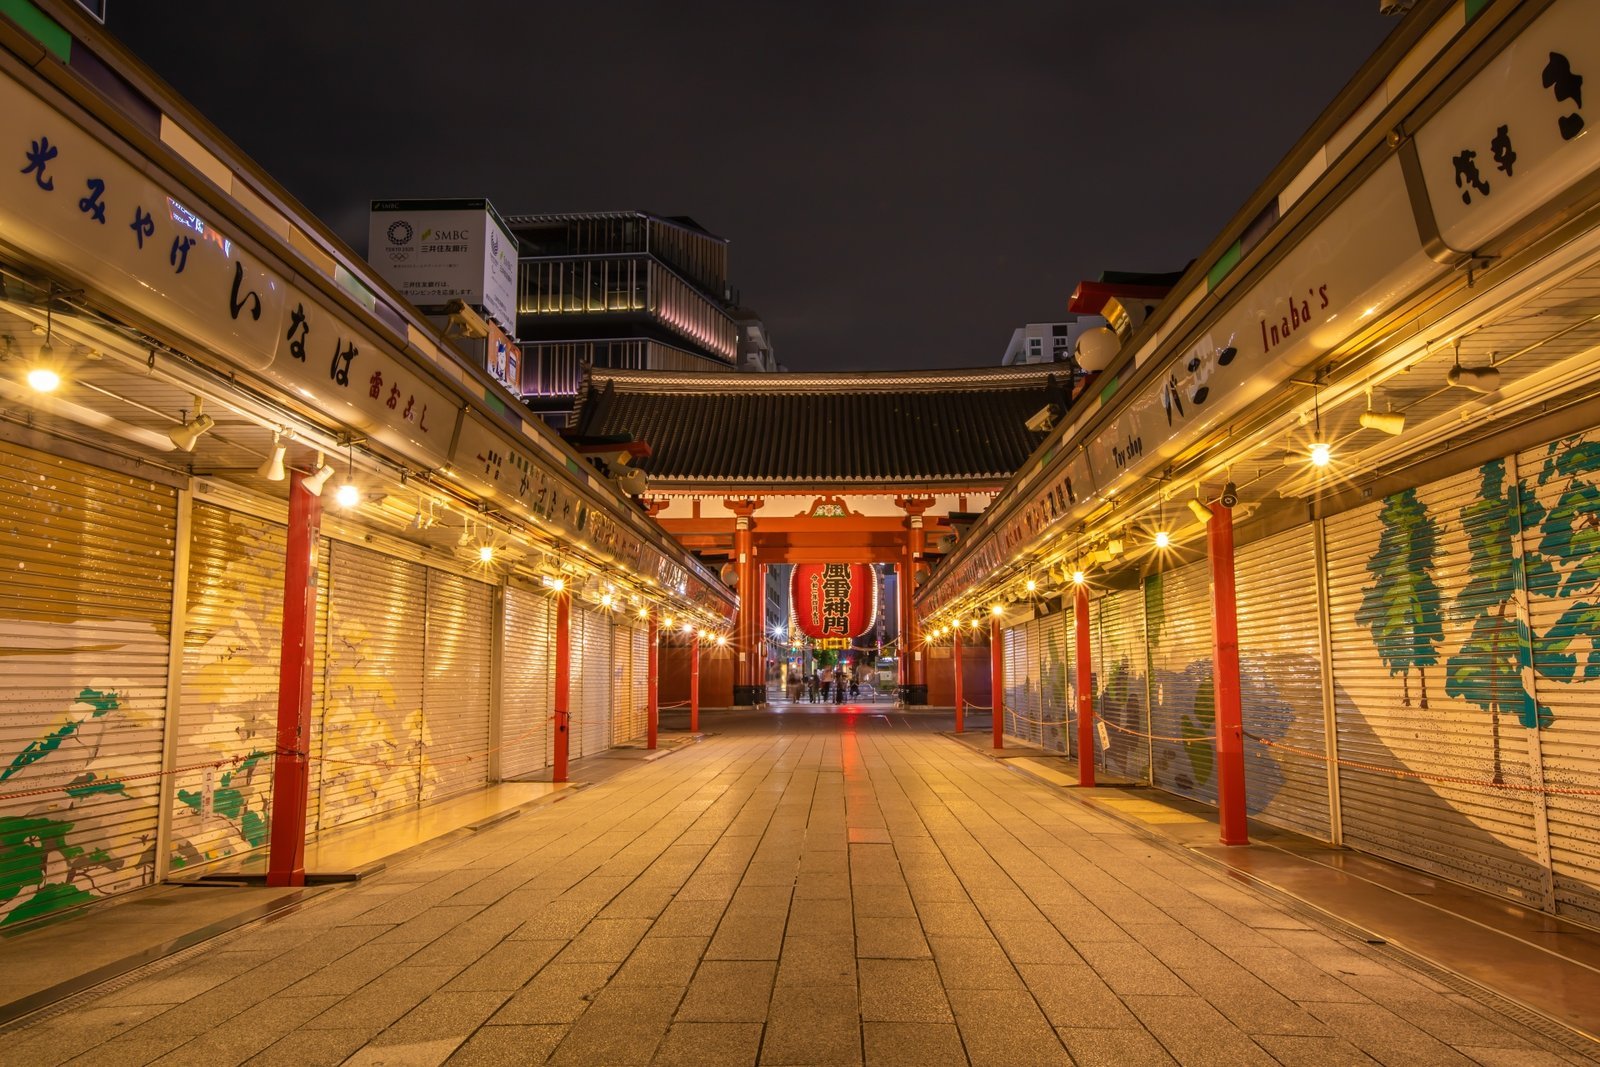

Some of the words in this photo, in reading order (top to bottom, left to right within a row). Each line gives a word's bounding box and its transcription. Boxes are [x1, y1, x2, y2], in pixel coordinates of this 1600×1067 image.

[420, 244, 469, 253] 三井住友銀行
[434, 230, 470, 241] SMBC
[1260, 282, 1329, 353] Inaba's
[1112, 445, 1126, 469] Toy
[1127, 434, 1143, 460] shop
[822, 563, 851, 635] 風雷神門
